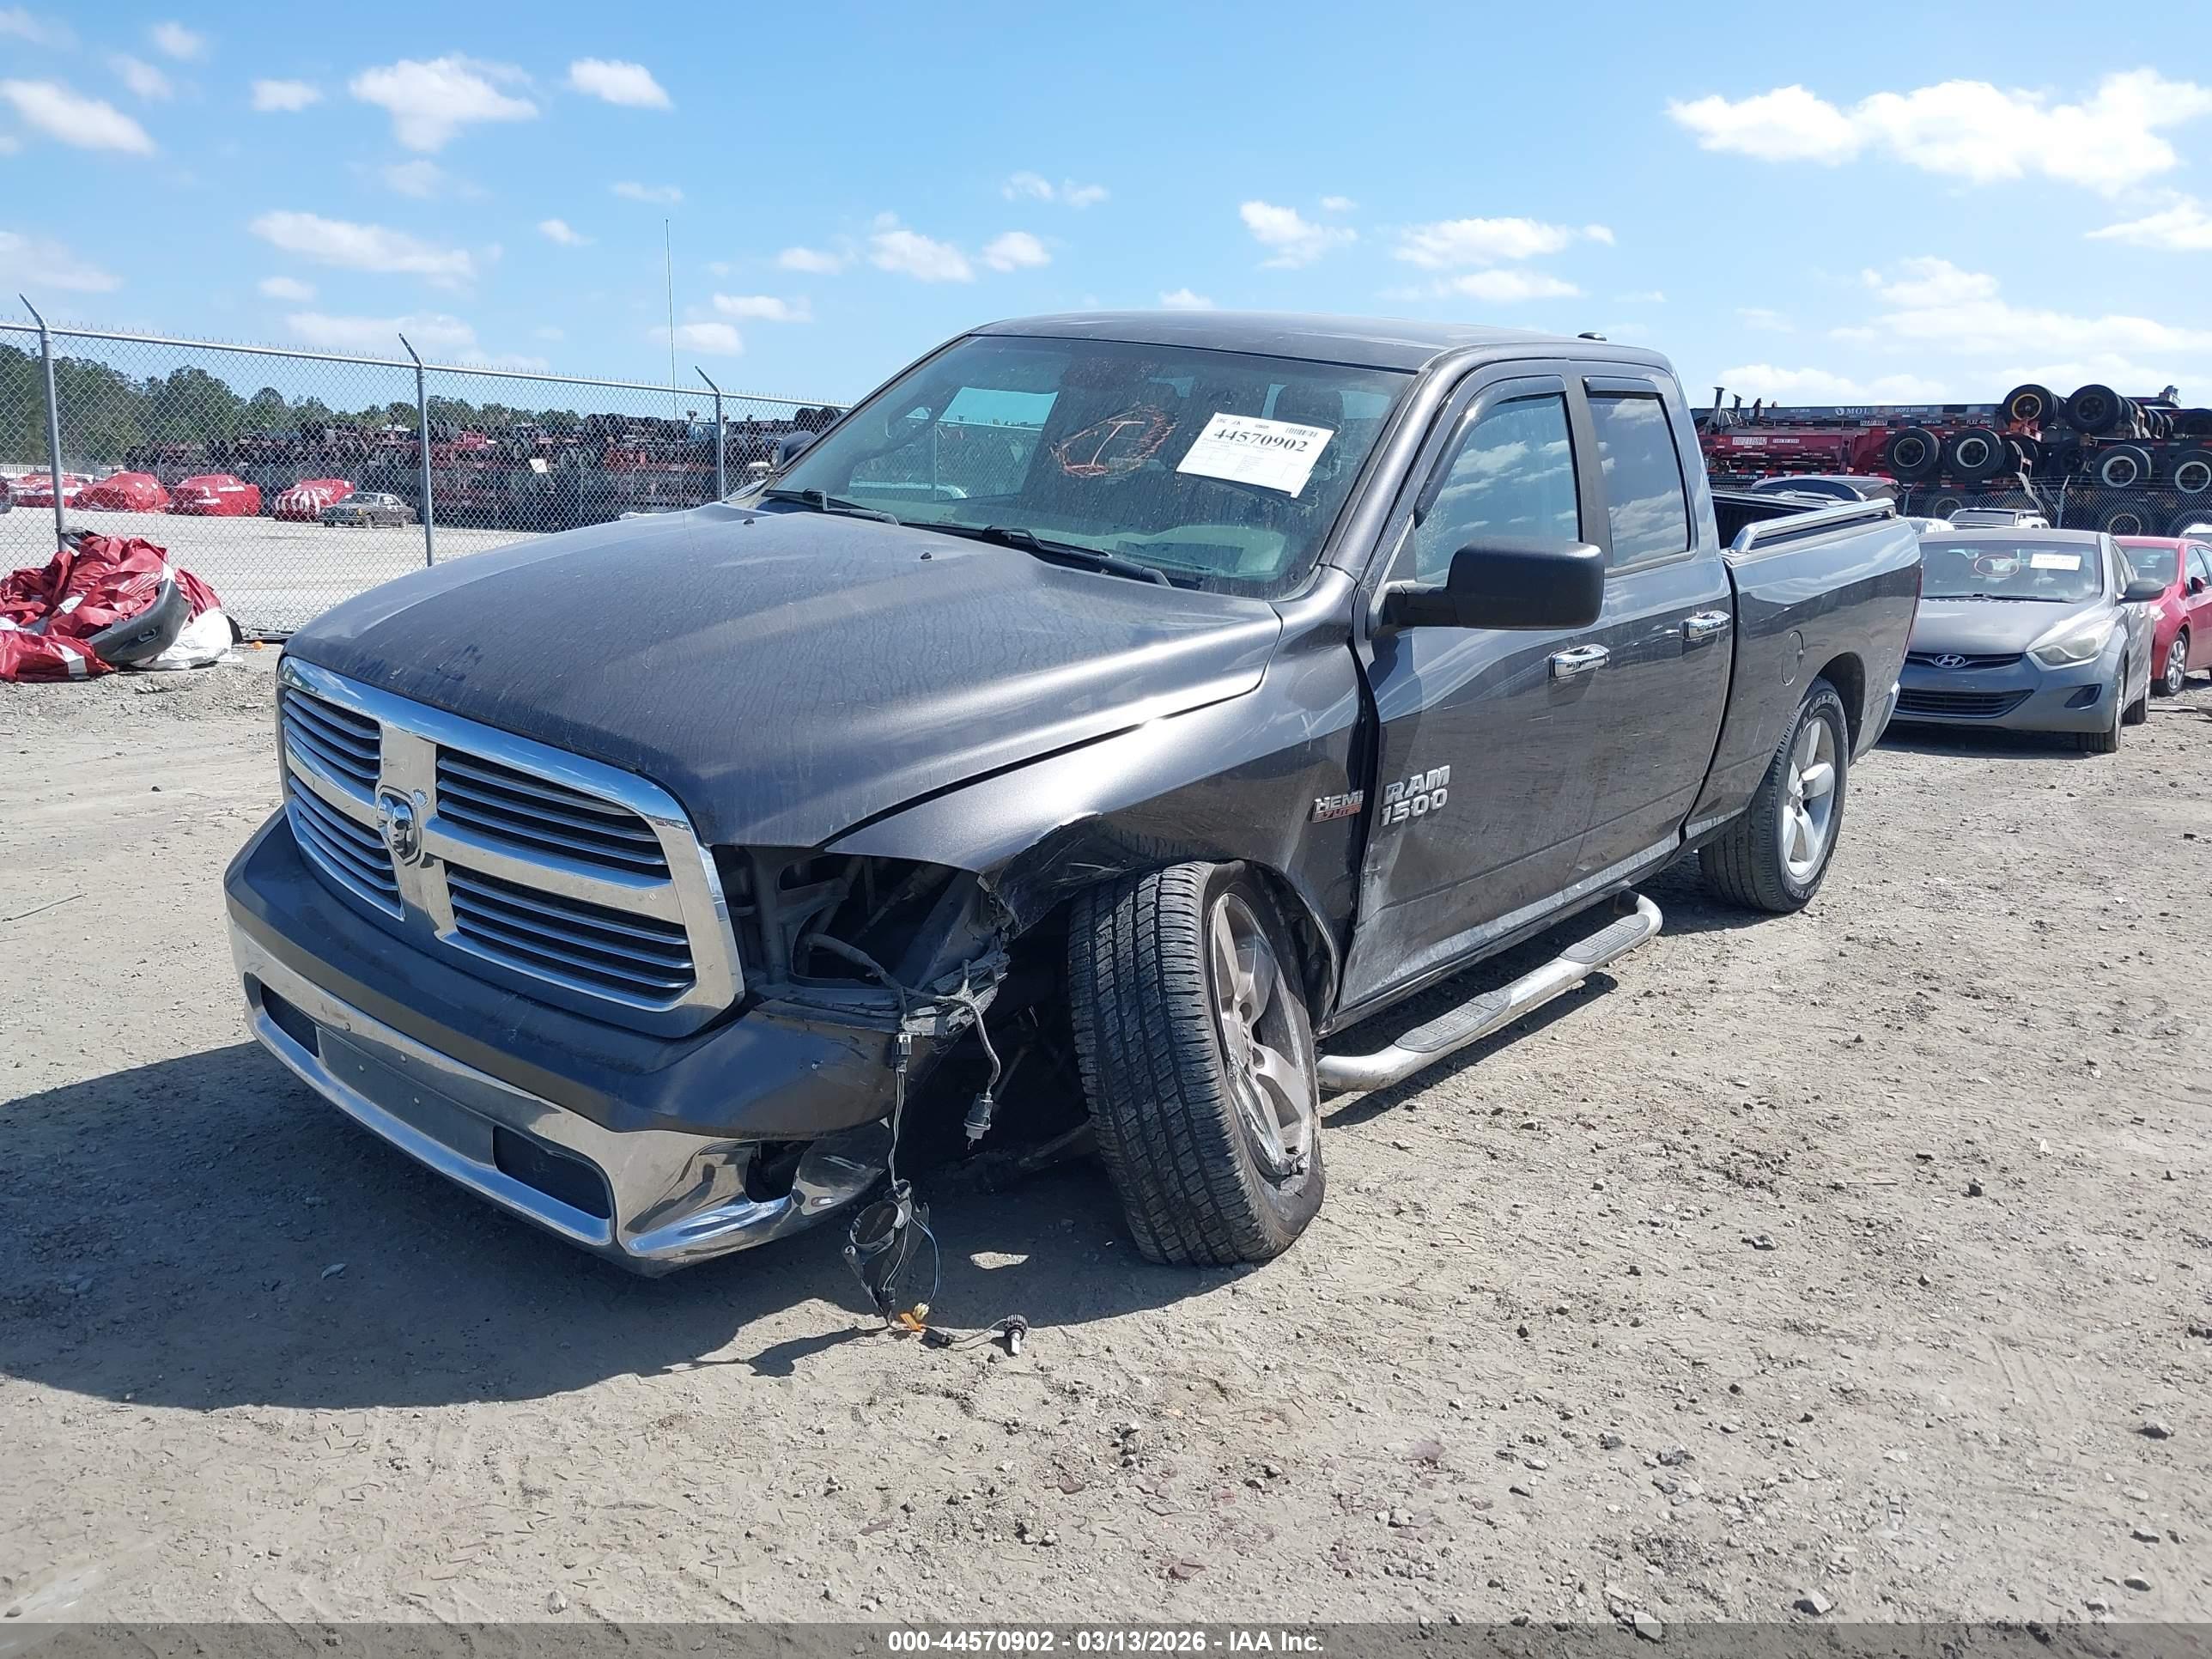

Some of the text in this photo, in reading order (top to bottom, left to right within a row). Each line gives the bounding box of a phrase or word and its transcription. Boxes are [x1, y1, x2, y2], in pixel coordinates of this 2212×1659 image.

[1213, 428, 1309, 453] 44570902
[1315, 789, 1364, 812] HEMI
[1382, 764, 1451, 805] RAM
[1380, 787, 1449, 828] 1500
